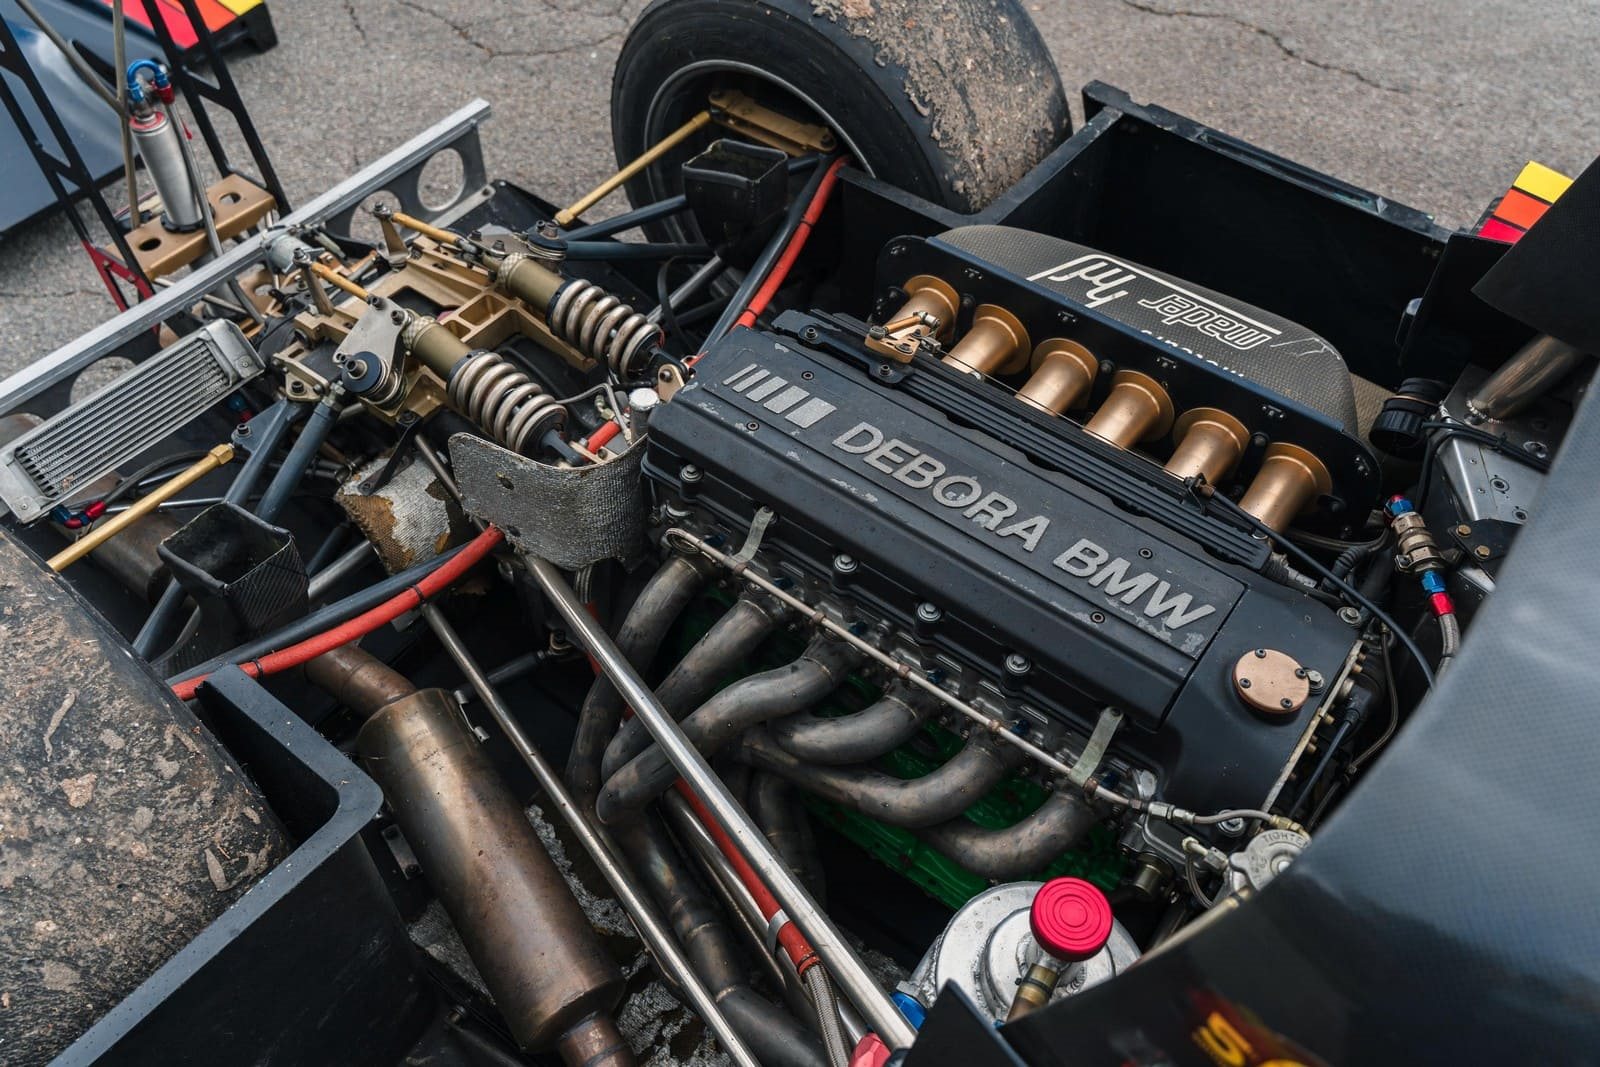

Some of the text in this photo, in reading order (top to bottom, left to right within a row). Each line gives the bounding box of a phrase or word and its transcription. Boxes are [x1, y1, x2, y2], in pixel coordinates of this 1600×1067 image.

[1138, 294, 1272, 350] mader
[831, 421, 1217, 630] DEBORA BMW
[1263, 831, 1308, 849] TIGHTE
